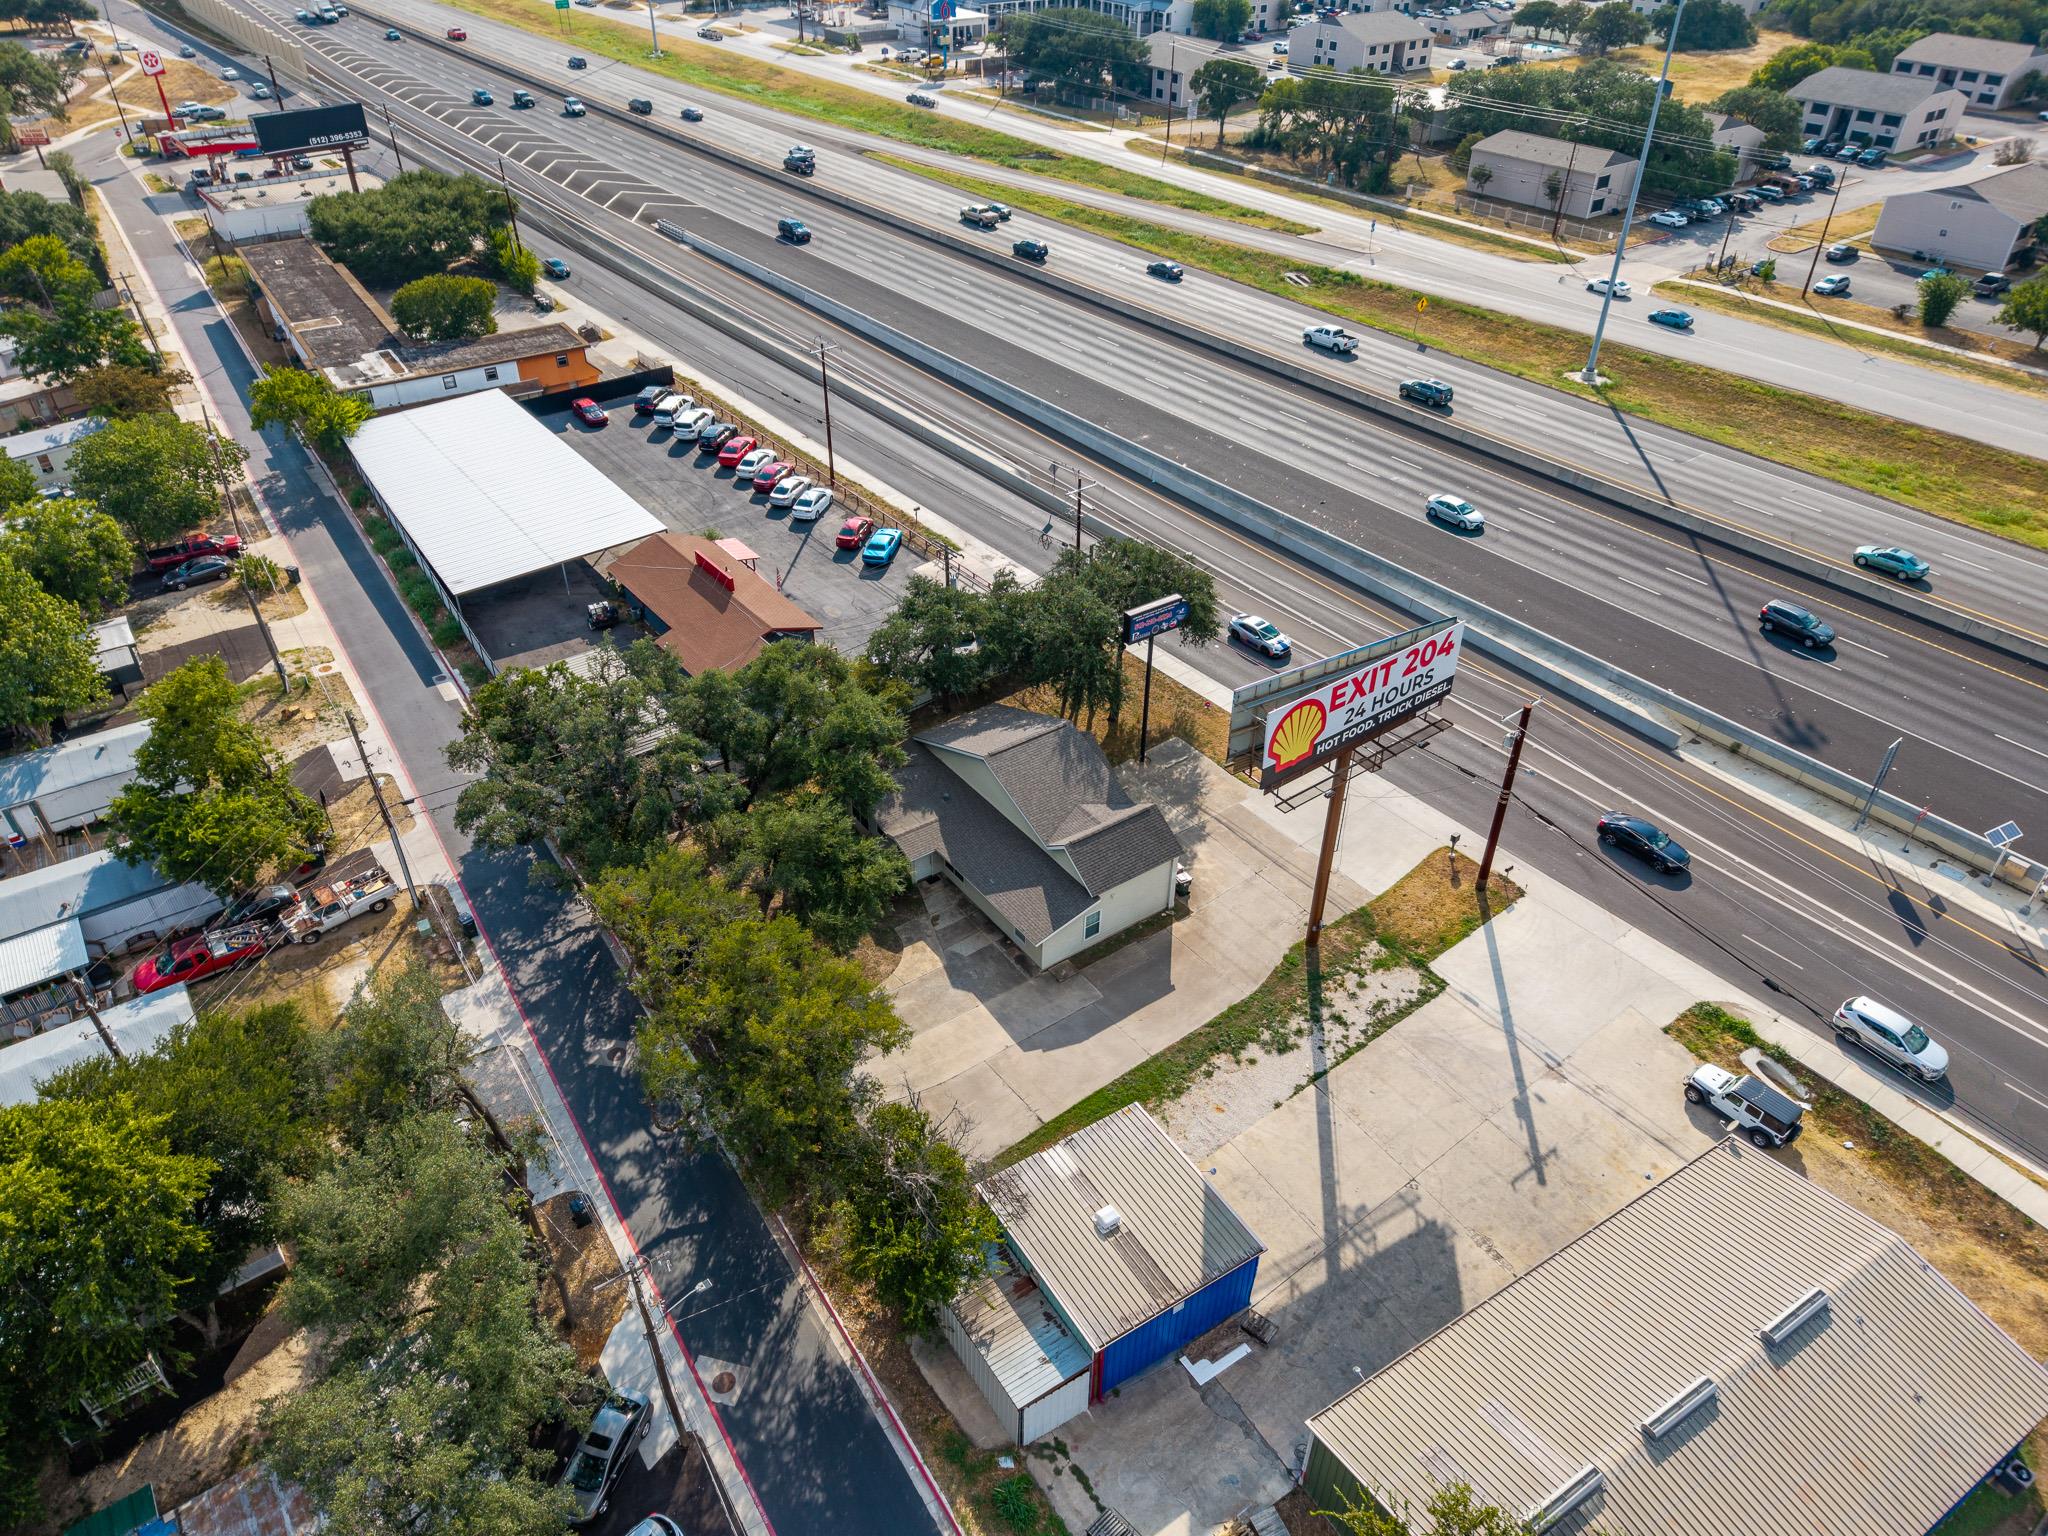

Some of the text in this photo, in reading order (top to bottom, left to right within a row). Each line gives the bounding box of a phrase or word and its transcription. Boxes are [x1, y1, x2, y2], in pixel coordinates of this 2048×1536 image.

[309, 130, 363, 146] (512) 396-5353
[1329, 631, 1455, 713] EXIT 204
[1343, 667, 1435, 726] 24 HOURS
[1316, 682, 1452, 755] HOT FOOD. TRUCK DIESEL.
